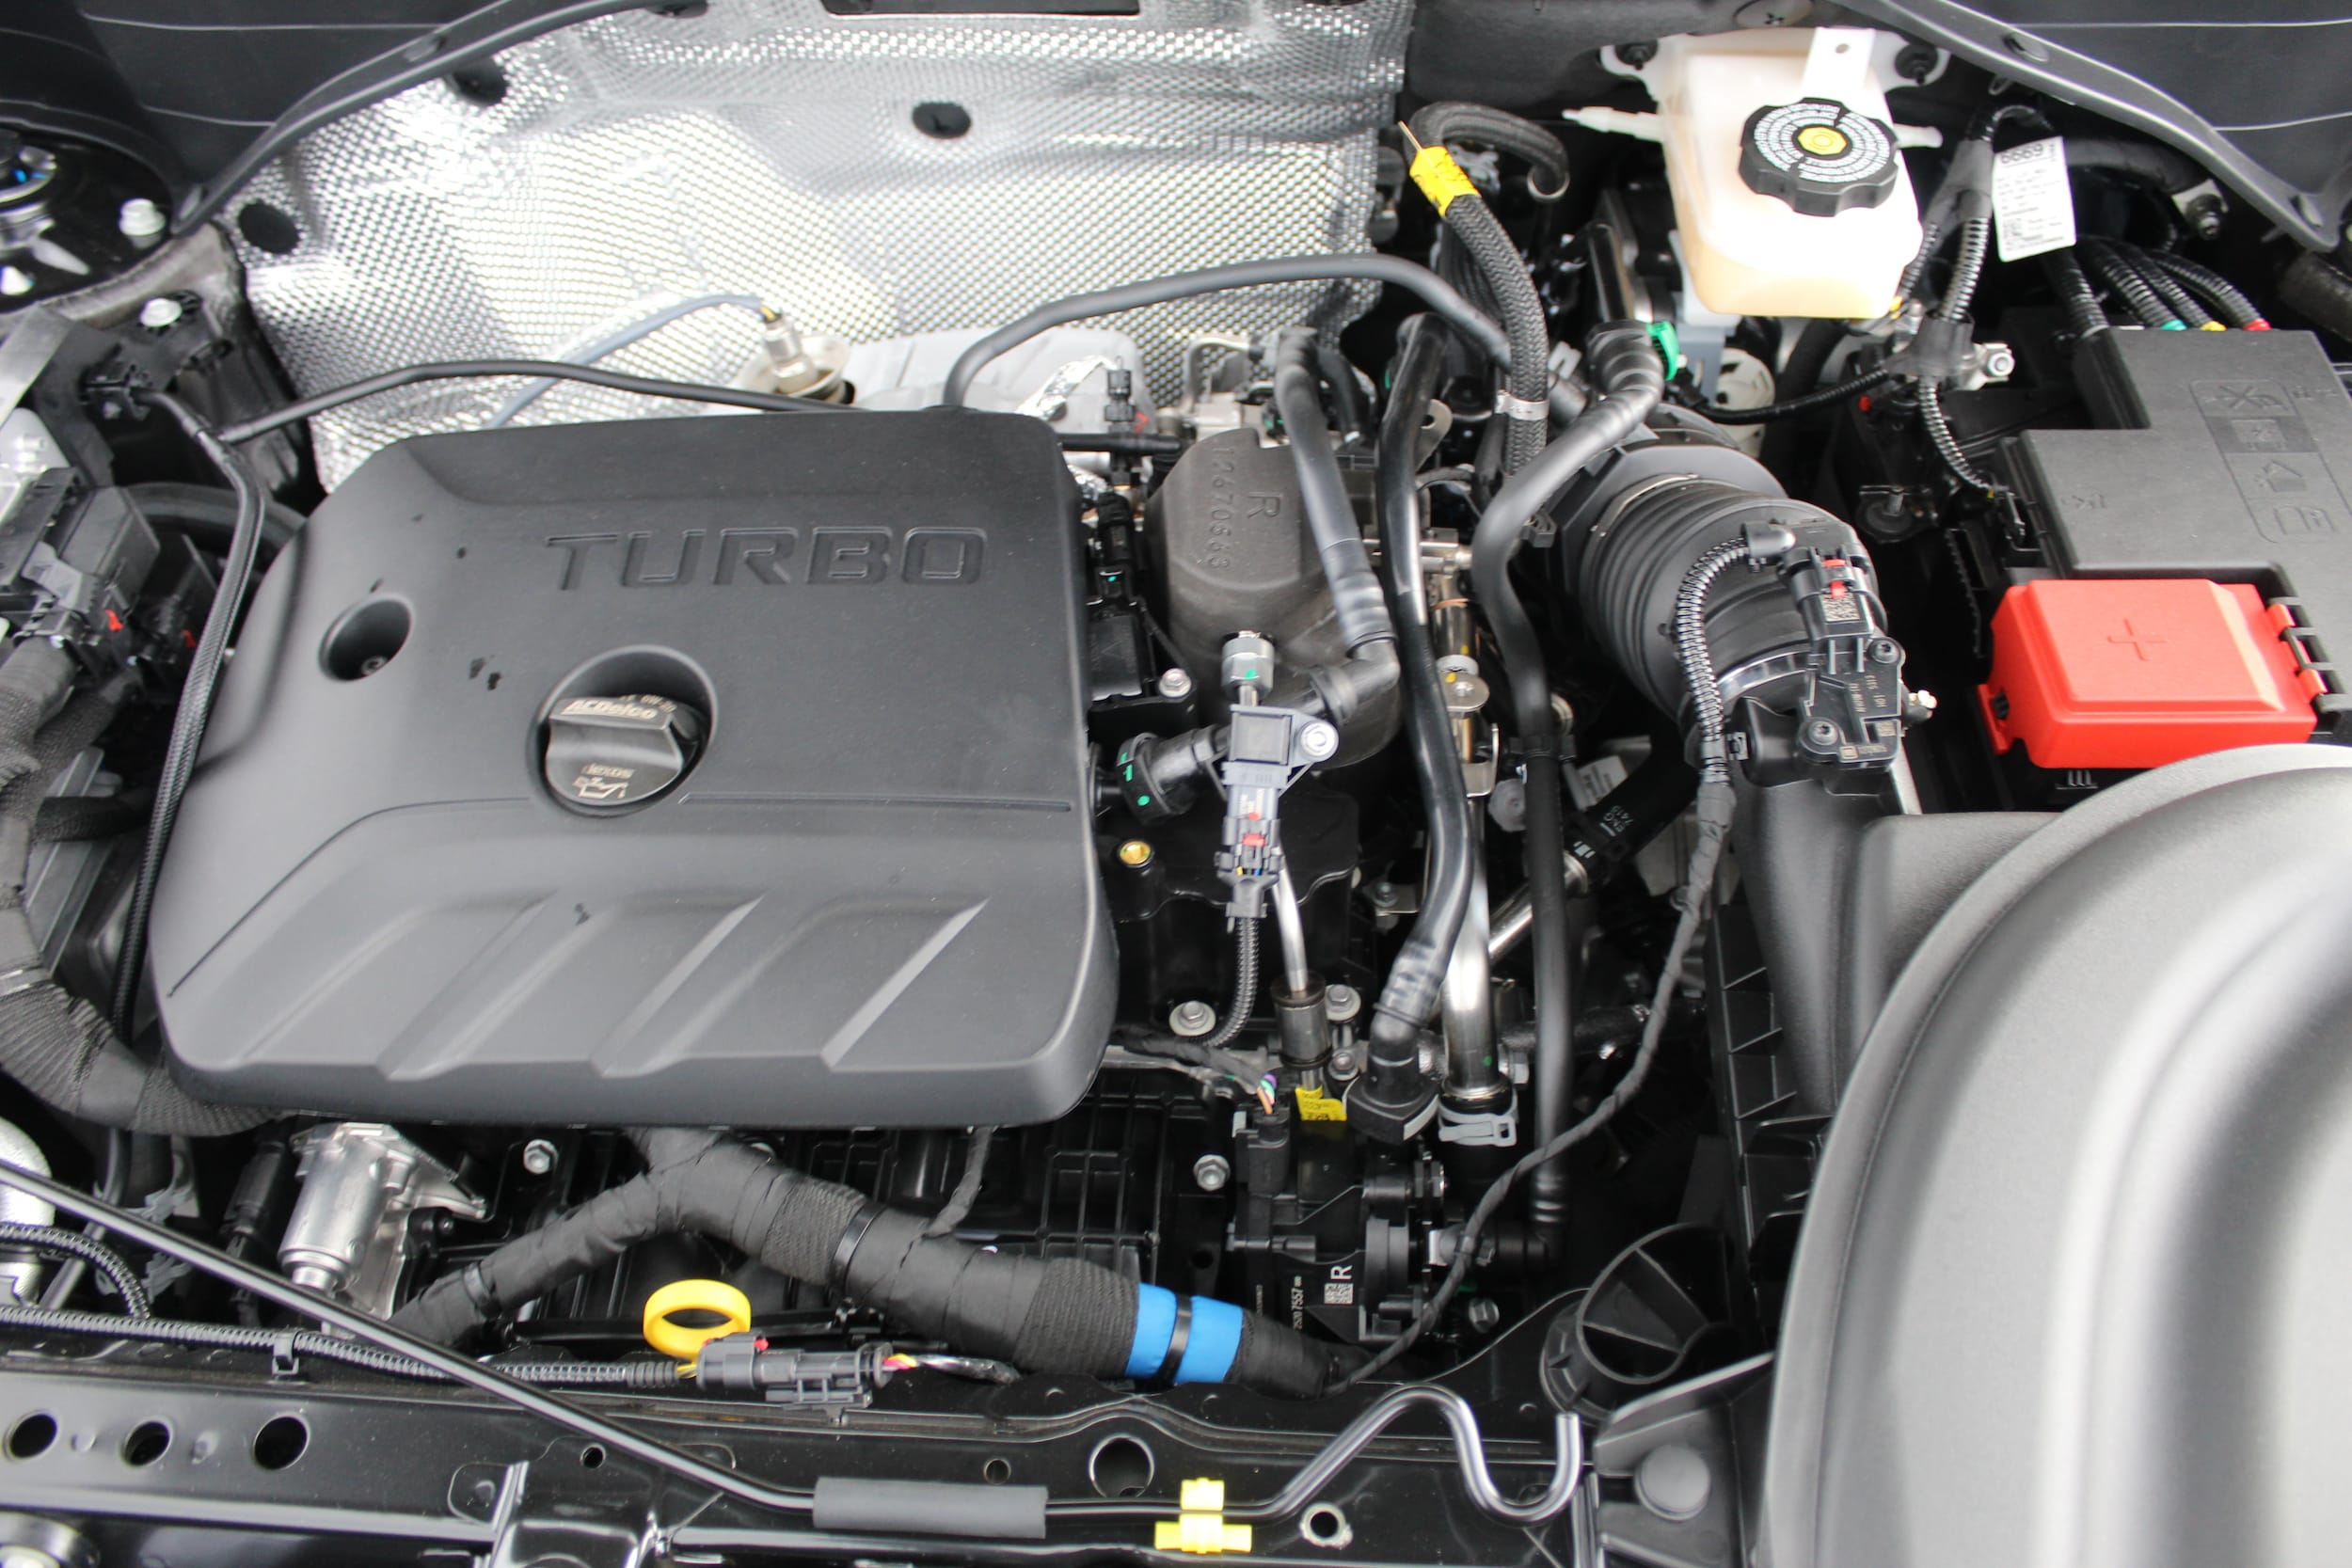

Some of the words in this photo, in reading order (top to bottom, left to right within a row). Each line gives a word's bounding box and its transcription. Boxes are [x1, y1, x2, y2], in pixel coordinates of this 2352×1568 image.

[1248, 491, 1283, 519] R
[546, 527, 988, 591] TURBO
[561, 699, 660, 721] ACDelco
[1330, 1265, 1353, 1280] R
